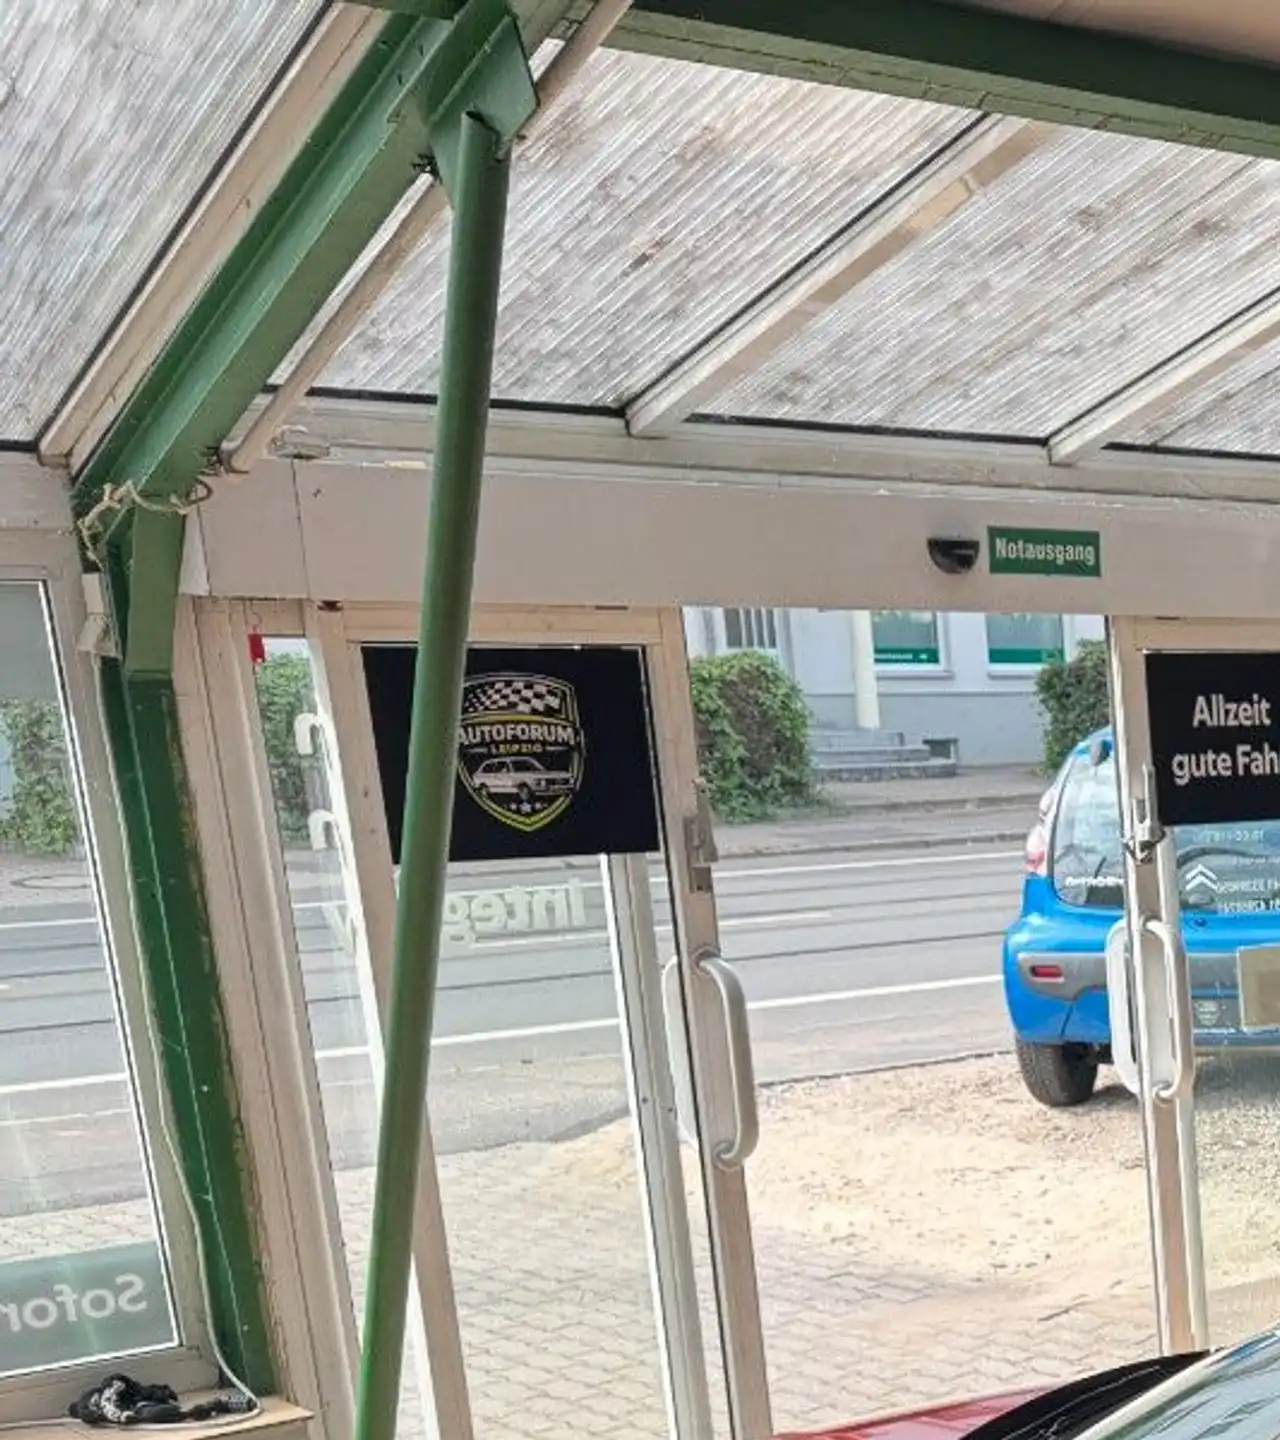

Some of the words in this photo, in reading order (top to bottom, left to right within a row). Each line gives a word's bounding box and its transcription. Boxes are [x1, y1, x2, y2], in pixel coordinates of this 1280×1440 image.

[995, 537, 1096, 566] Notausgang
[1192, 693, 1271, 728] Allzeit
[460, 723, 575, 746] AUTOFORUM
[1171, 749, 1233, 786] gute
